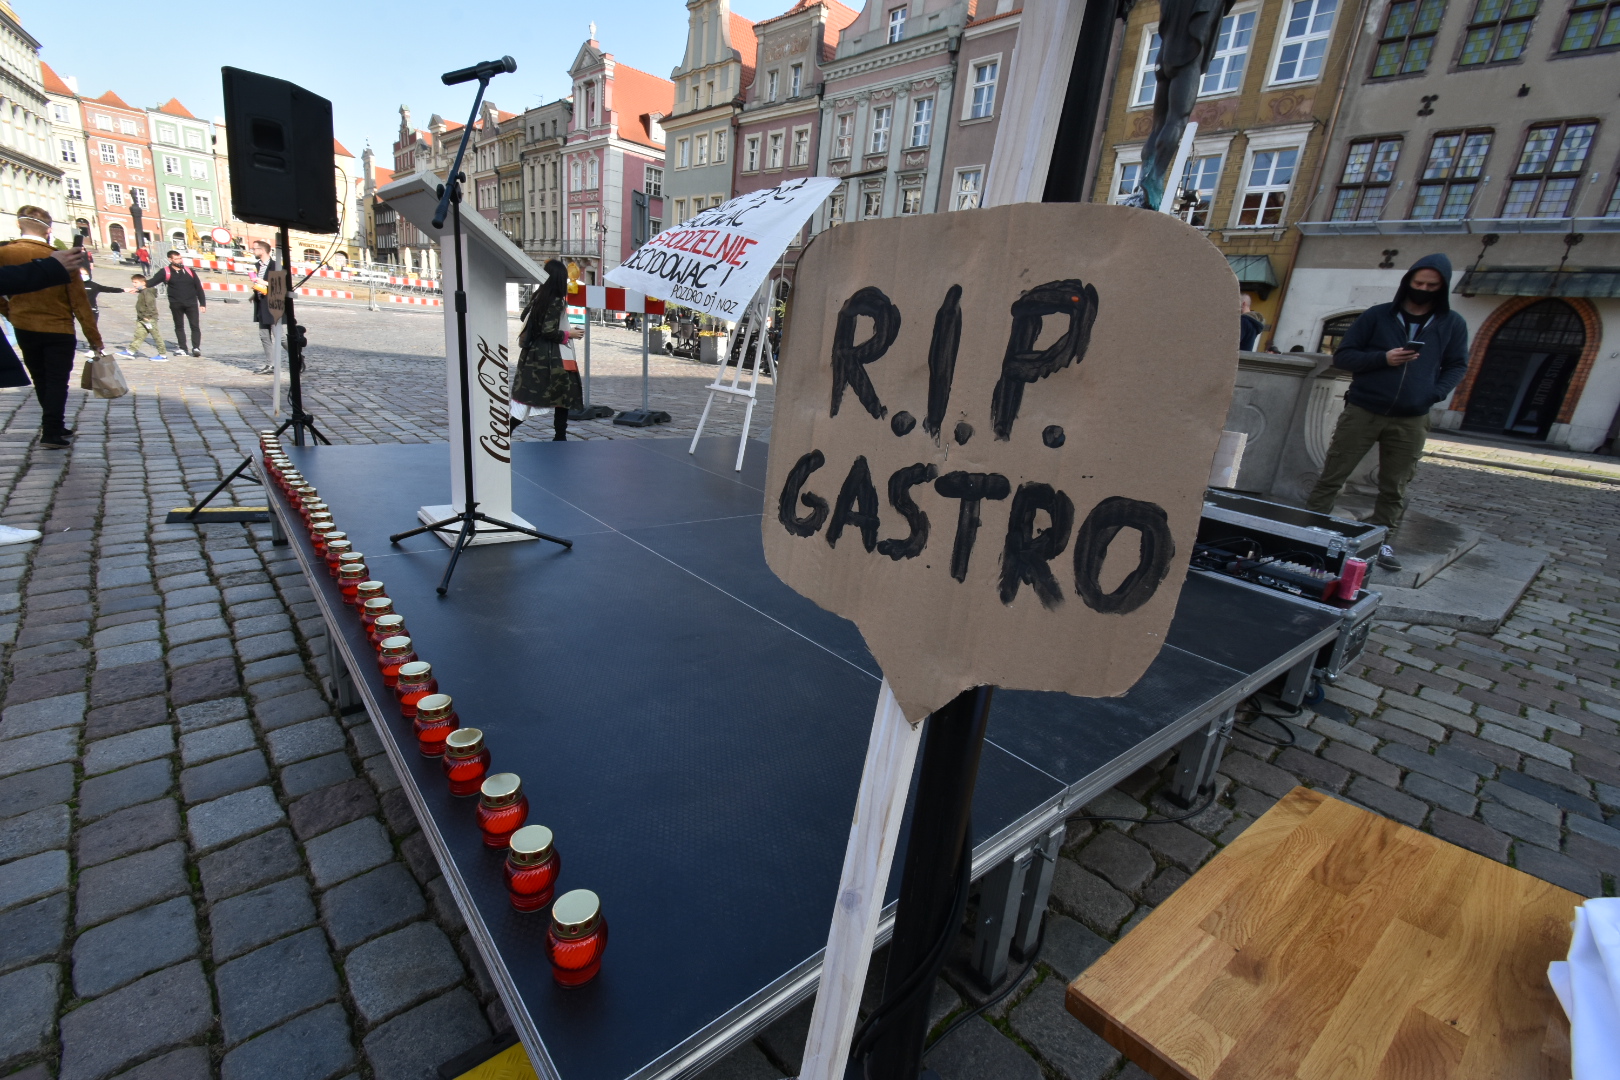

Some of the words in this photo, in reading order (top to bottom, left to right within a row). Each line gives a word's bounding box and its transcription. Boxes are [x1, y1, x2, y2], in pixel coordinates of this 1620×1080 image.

[670, 284, 703, 304] POZDRO
[830, 278, 1099, 448] R.I.P.
[1531, 377, 1553, 405] TATTOO
[778, 449, 1175, 614] GASTRO
